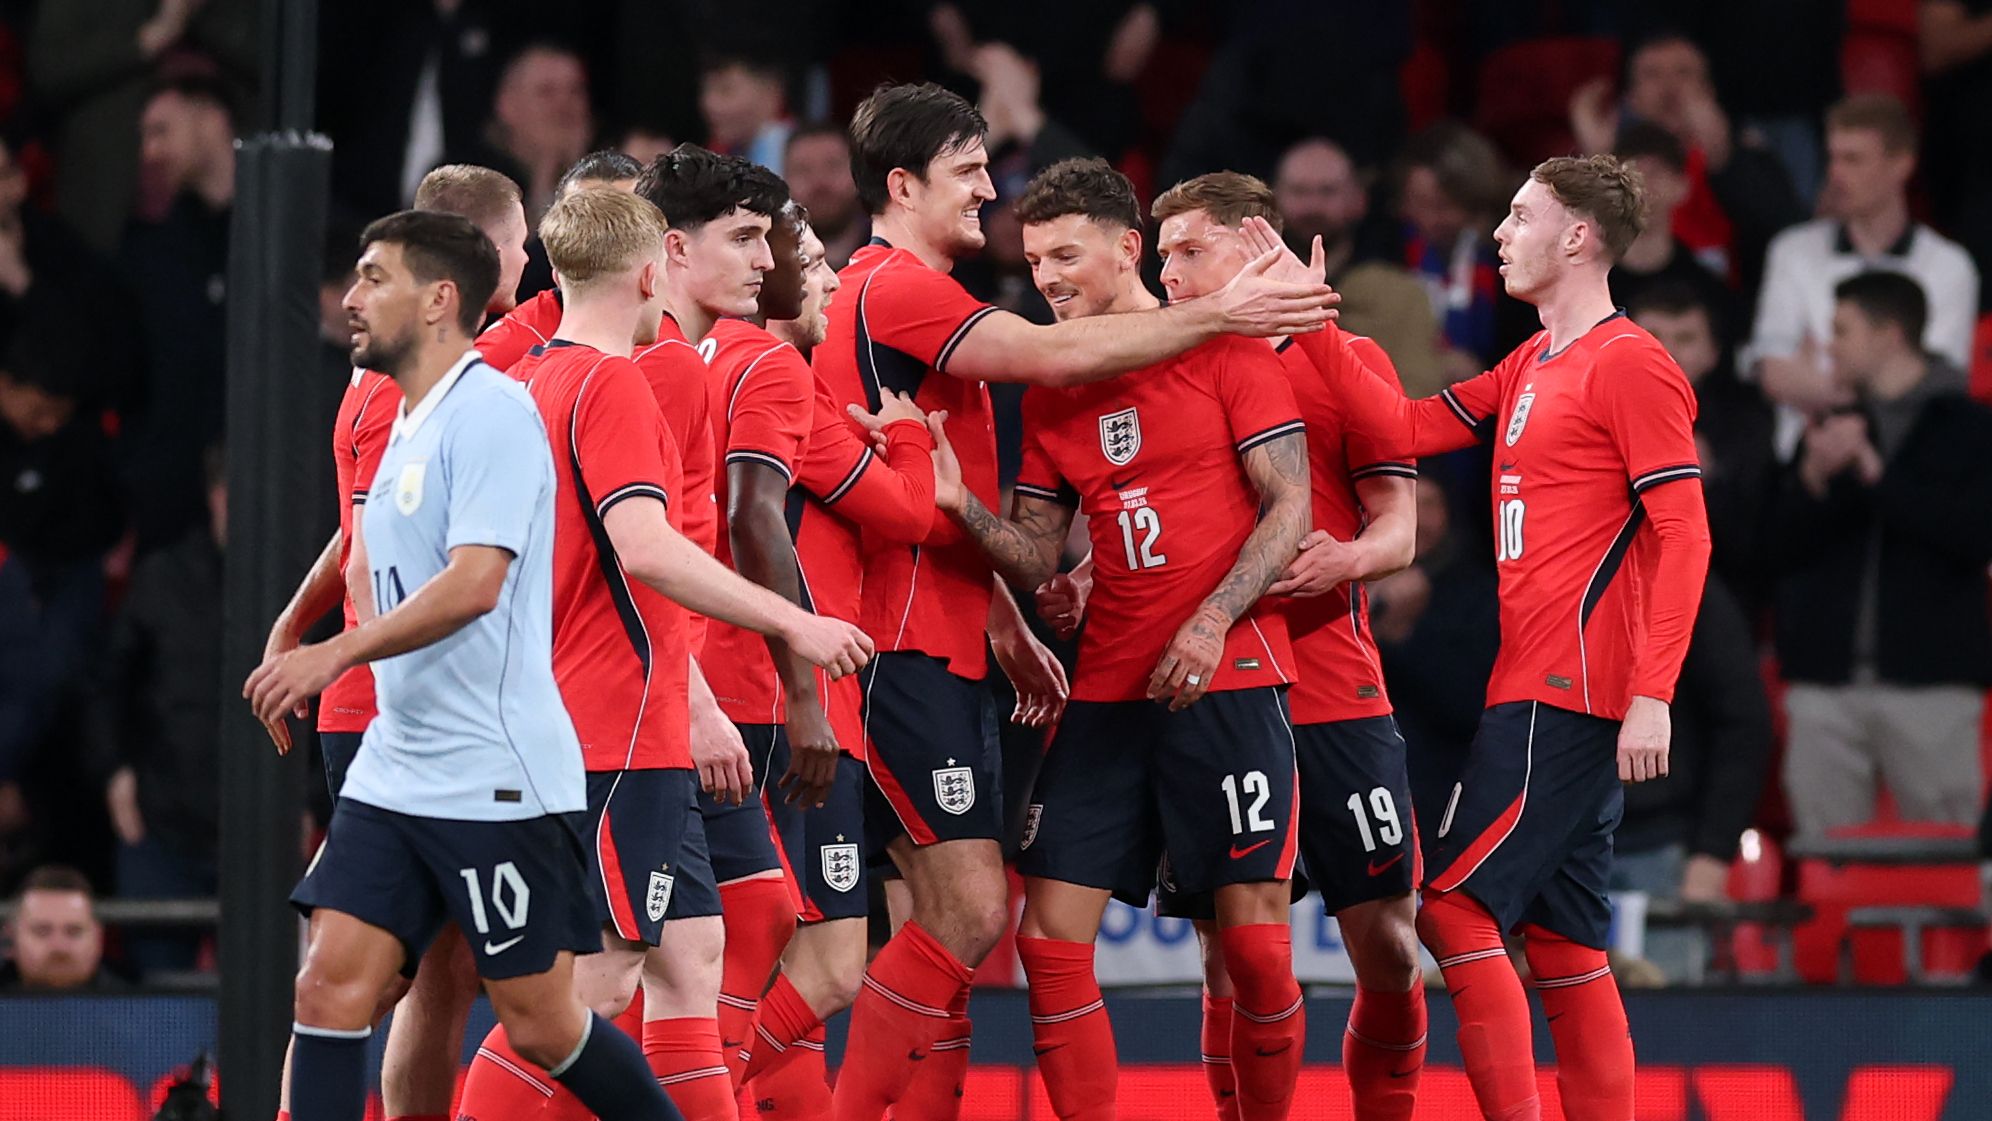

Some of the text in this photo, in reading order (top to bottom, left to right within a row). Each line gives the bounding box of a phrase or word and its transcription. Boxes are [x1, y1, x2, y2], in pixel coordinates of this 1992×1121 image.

[1117, 506, 1167, 571] 12
[1498, 499, 1525, 561] 10
[1221, 770, 1276, 835] 12
[1347, 786, 1404, 853] 19
[1437, 781, 1463, 839] 0
[459, 861, 531, 934] 10
